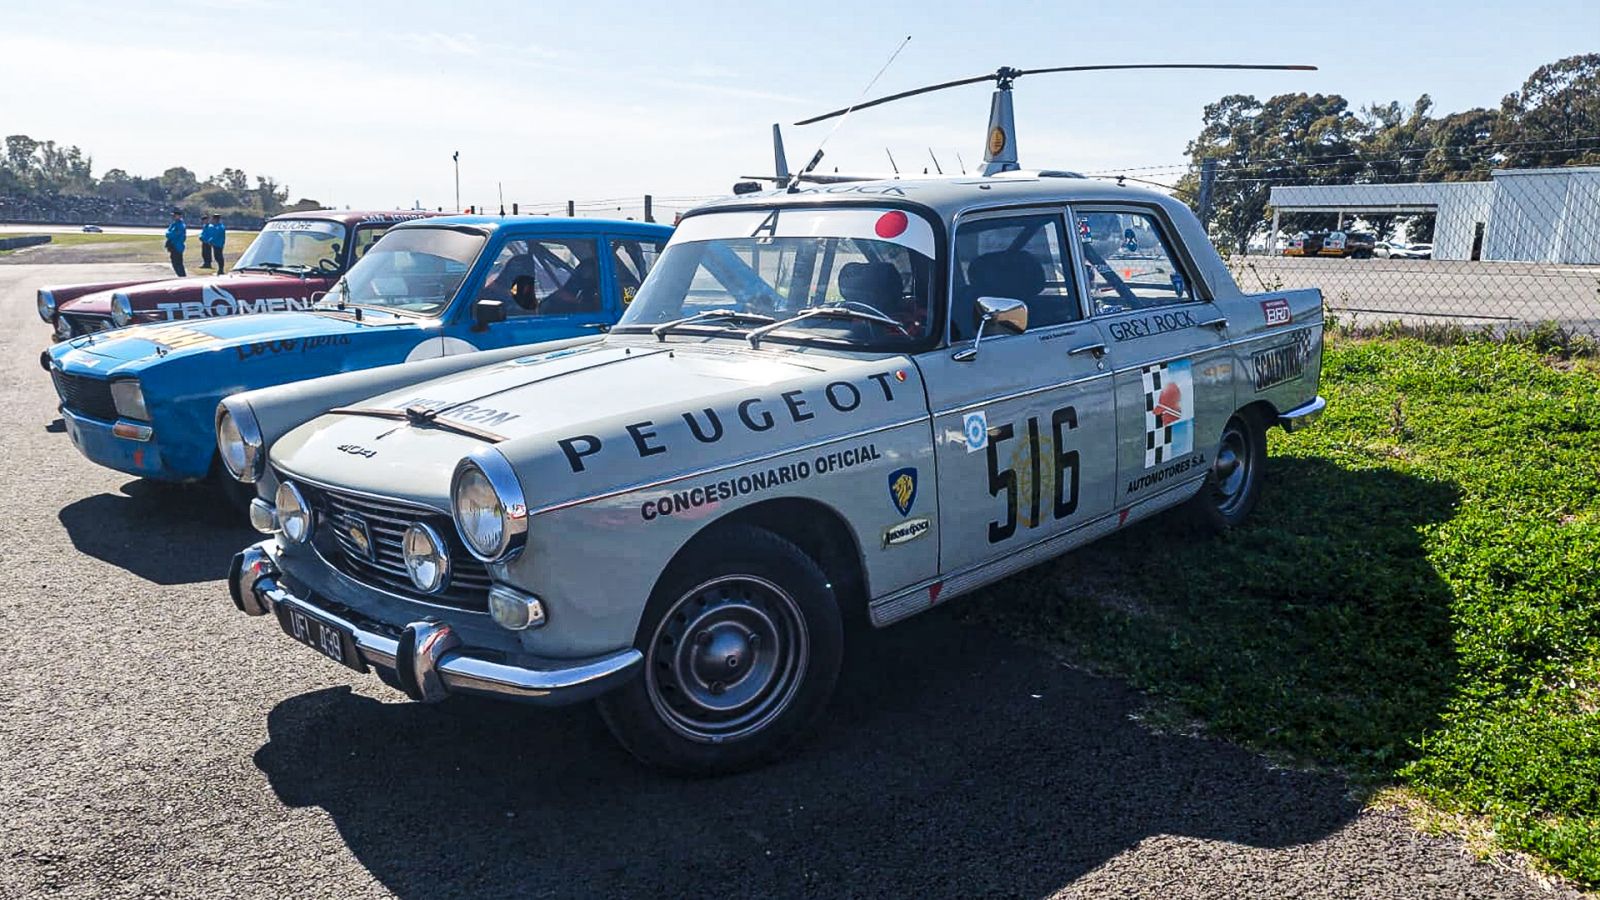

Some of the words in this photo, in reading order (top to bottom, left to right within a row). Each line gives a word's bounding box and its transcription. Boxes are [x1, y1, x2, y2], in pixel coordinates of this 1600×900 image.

[154, 285, 310, 321] TROMEN
[1109, 317, 1151, 341] GREY
[1153, 310, 1196, 332] ROCK
[558, 371, 896, 474] PEUGEOT
[337, 444, 377, 458] 404
[640, 461, 811, 521] CONCESIONARIO
[814, 443, 881, 474] OFICIAL
[986, 405, 1081, 544] 516
[1126, 461, 1192, 495] AUTOMOTORES
